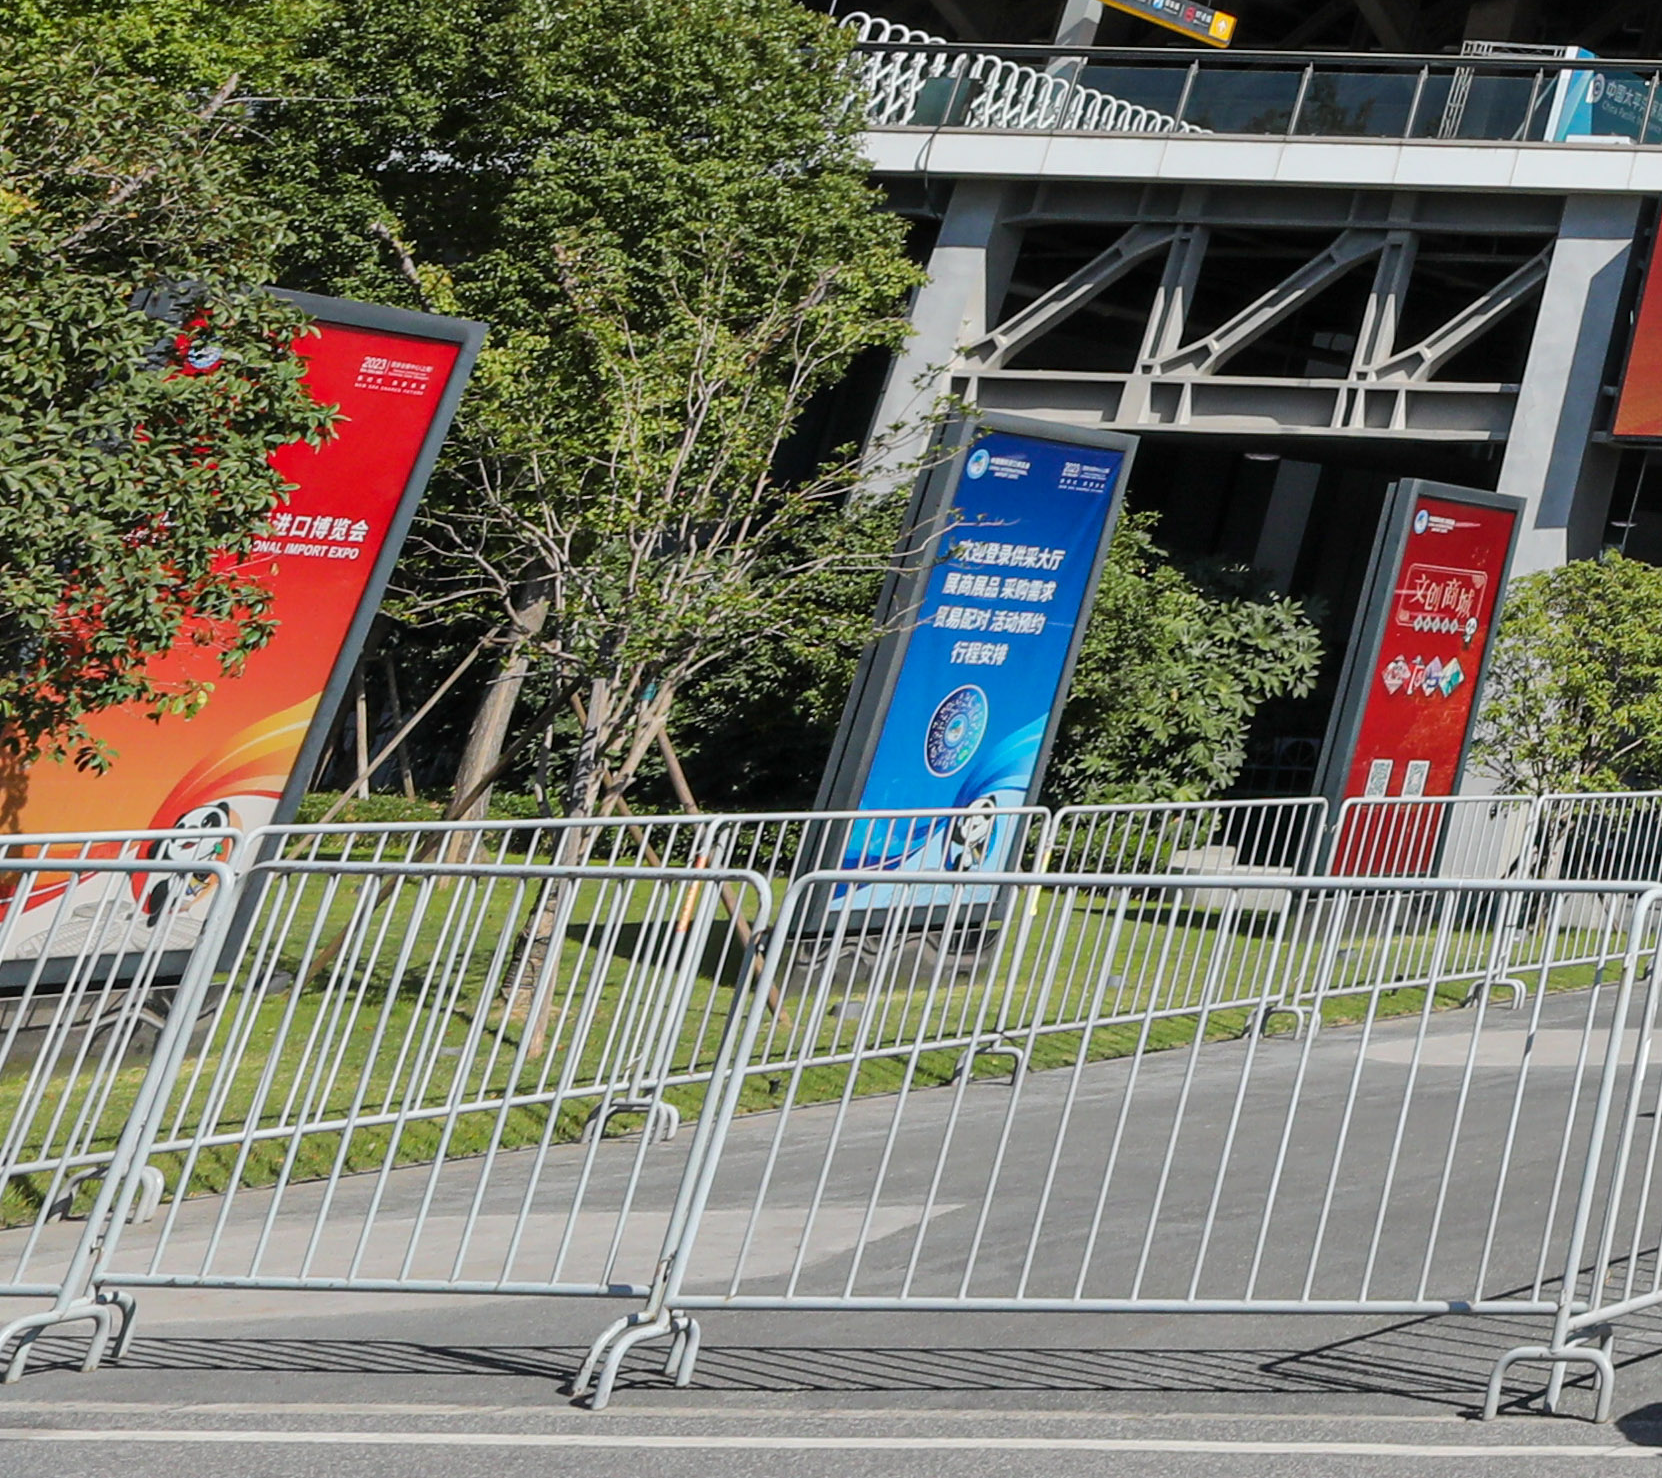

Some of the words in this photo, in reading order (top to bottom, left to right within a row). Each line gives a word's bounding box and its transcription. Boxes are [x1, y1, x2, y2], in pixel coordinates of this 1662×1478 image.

[361, 356, 387, 370] 2023
[262, 512, 369, 543] 进口博览会
[284, 543, 327, 558] IMPORT
[328, 546, 360, 560] EXPO
[955, 540, 1066, 571] 欢迎登录供采大厅
[942, 572, 1001, 599] 展商展品
[1001, 577, 1057, 603] 采购需求
[1409, 574, 1475, 619] 文创商城
[933, 606, 992, 631] 贸易配对
[990, 609, 1047, 635] 活动预约
[951, 641, 1009, 666] 行程安排
